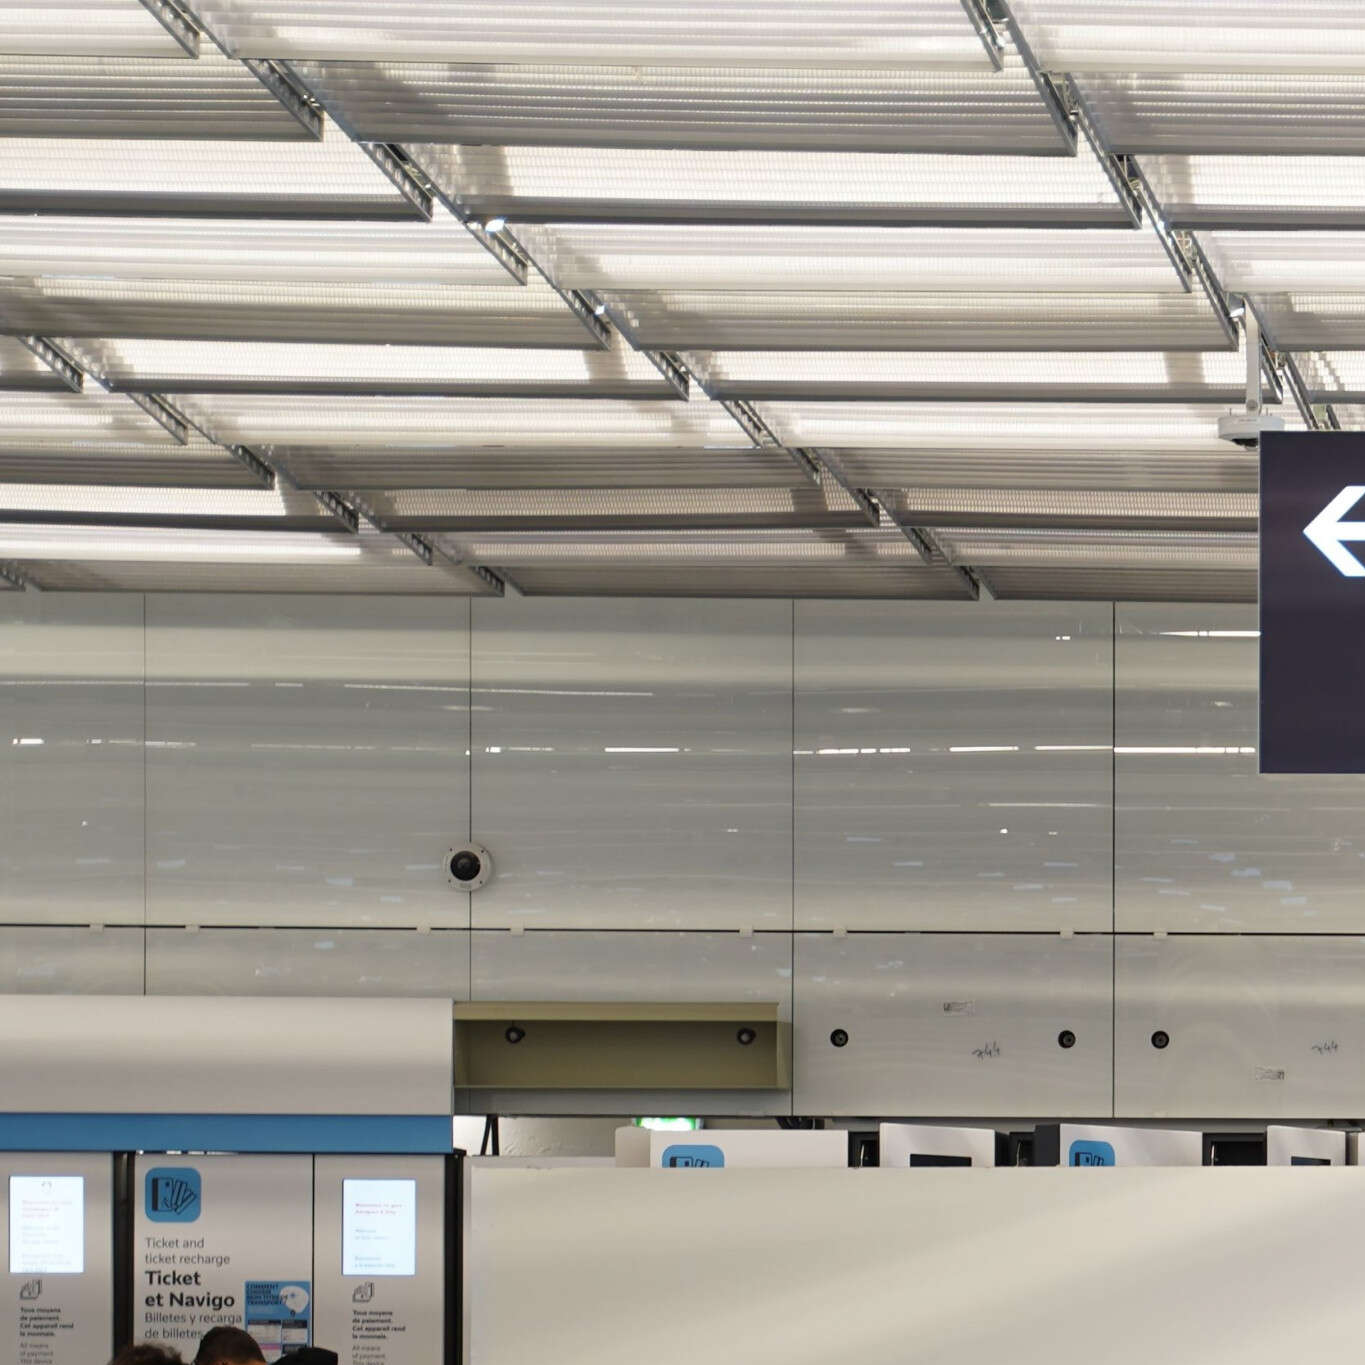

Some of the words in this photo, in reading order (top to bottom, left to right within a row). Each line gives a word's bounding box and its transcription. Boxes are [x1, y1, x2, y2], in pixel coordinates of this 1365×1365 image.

[145, 1237, 179, 1249] Ticket
[183, 1236, 205, 1249] and
[145, 1253, 176, 1265] ticket
[180, 1253, 230, 1268] recharge
[145, 1270, 201, 1286] Ticket
[145, 1292, 164, 1307] et
[169, 1291, 235, 1311] Navigo
[145, 1311, 186, 1323] Billetes
[190, 1314, 197, 1325] y
[200, 1313, 242, 1325] recarga
[145, 1327, 159, 1339] de
